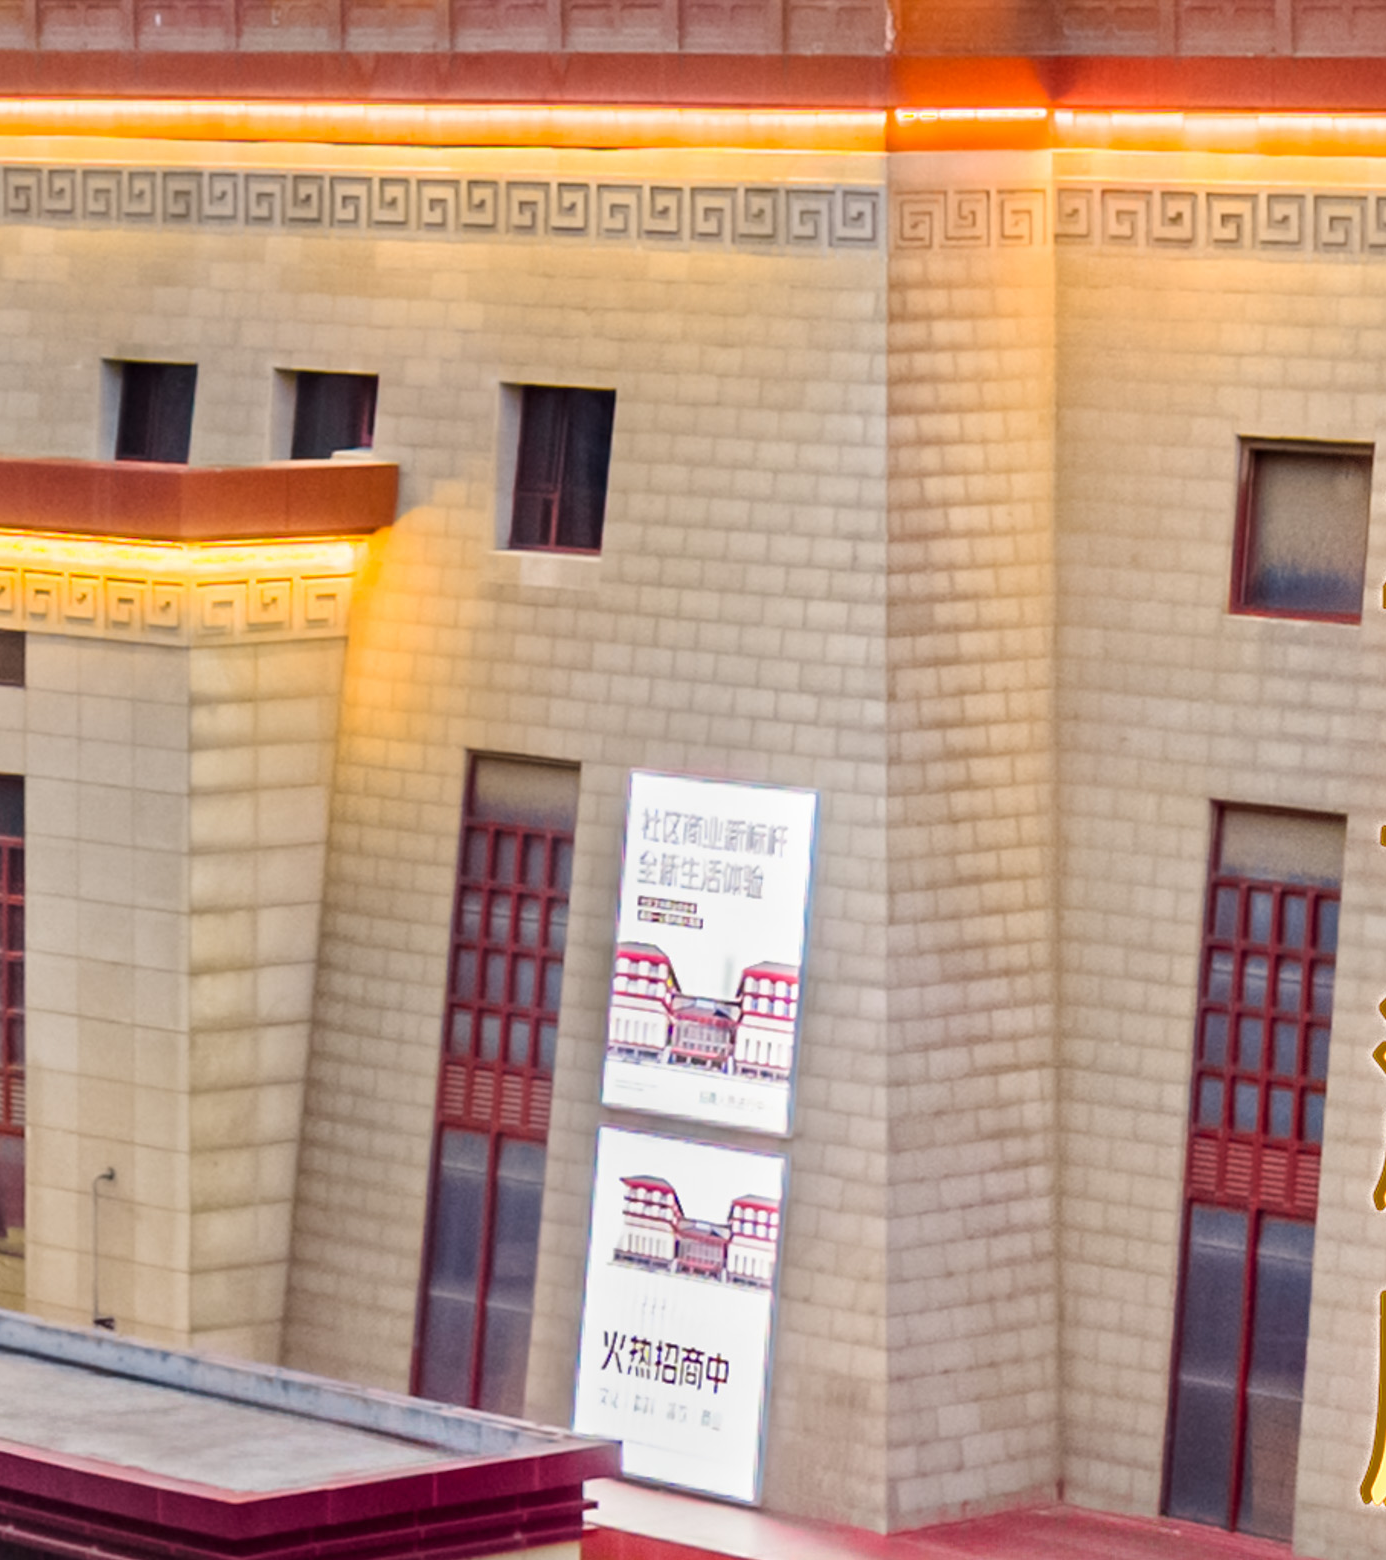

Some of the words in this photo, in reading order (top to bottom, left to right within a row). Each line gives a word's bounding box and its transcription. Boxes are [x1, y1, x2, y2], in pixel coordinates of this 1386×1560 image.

[640, 806, 790, 859] 社区商业新标杆
[601, 1330, 730, 1394] 火热招商中
